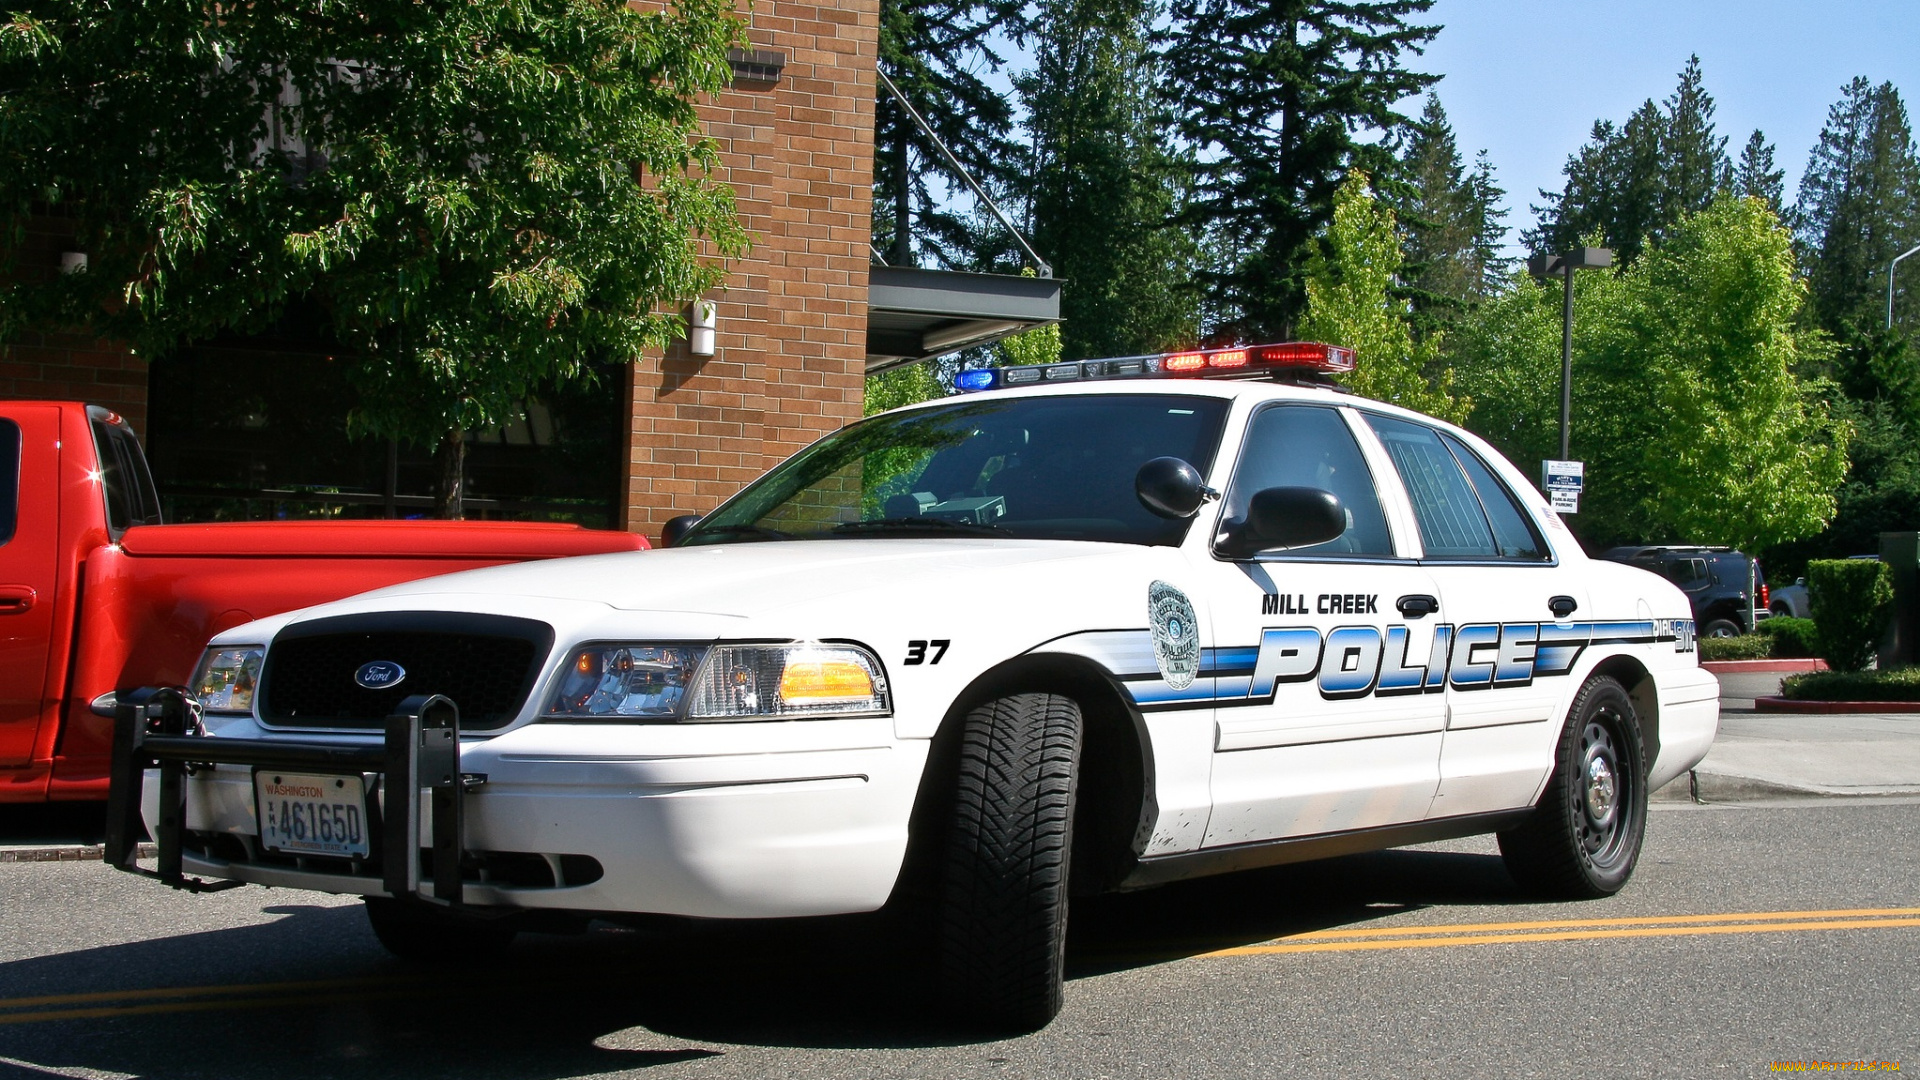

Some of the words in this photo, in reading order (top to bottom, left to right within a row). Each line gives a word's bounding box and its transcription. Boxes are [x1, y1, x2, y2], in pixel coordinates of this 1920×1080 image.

[1159, 603, 1173, 616] CITY
[1262, 594, 1309, 615] MILL
[1317, 594, 1378, 614] CREEK
[1653, 620, 1675, 637] DIAL
[1675, 620, 1694, 653] 911
[903, 639, 951, 666] 37
[364, 665, 392, 681] Ford
[1173, 662, 1185, 671] WA
[1246, 622, 1540, 706] POLICE
[265, 784, 323, 798] WASHINGTON
[280, 801, 361, 845] 46165D
[290, 840, 321, 850] EVERGREEN
[324, 841, 342, 851] STATE
